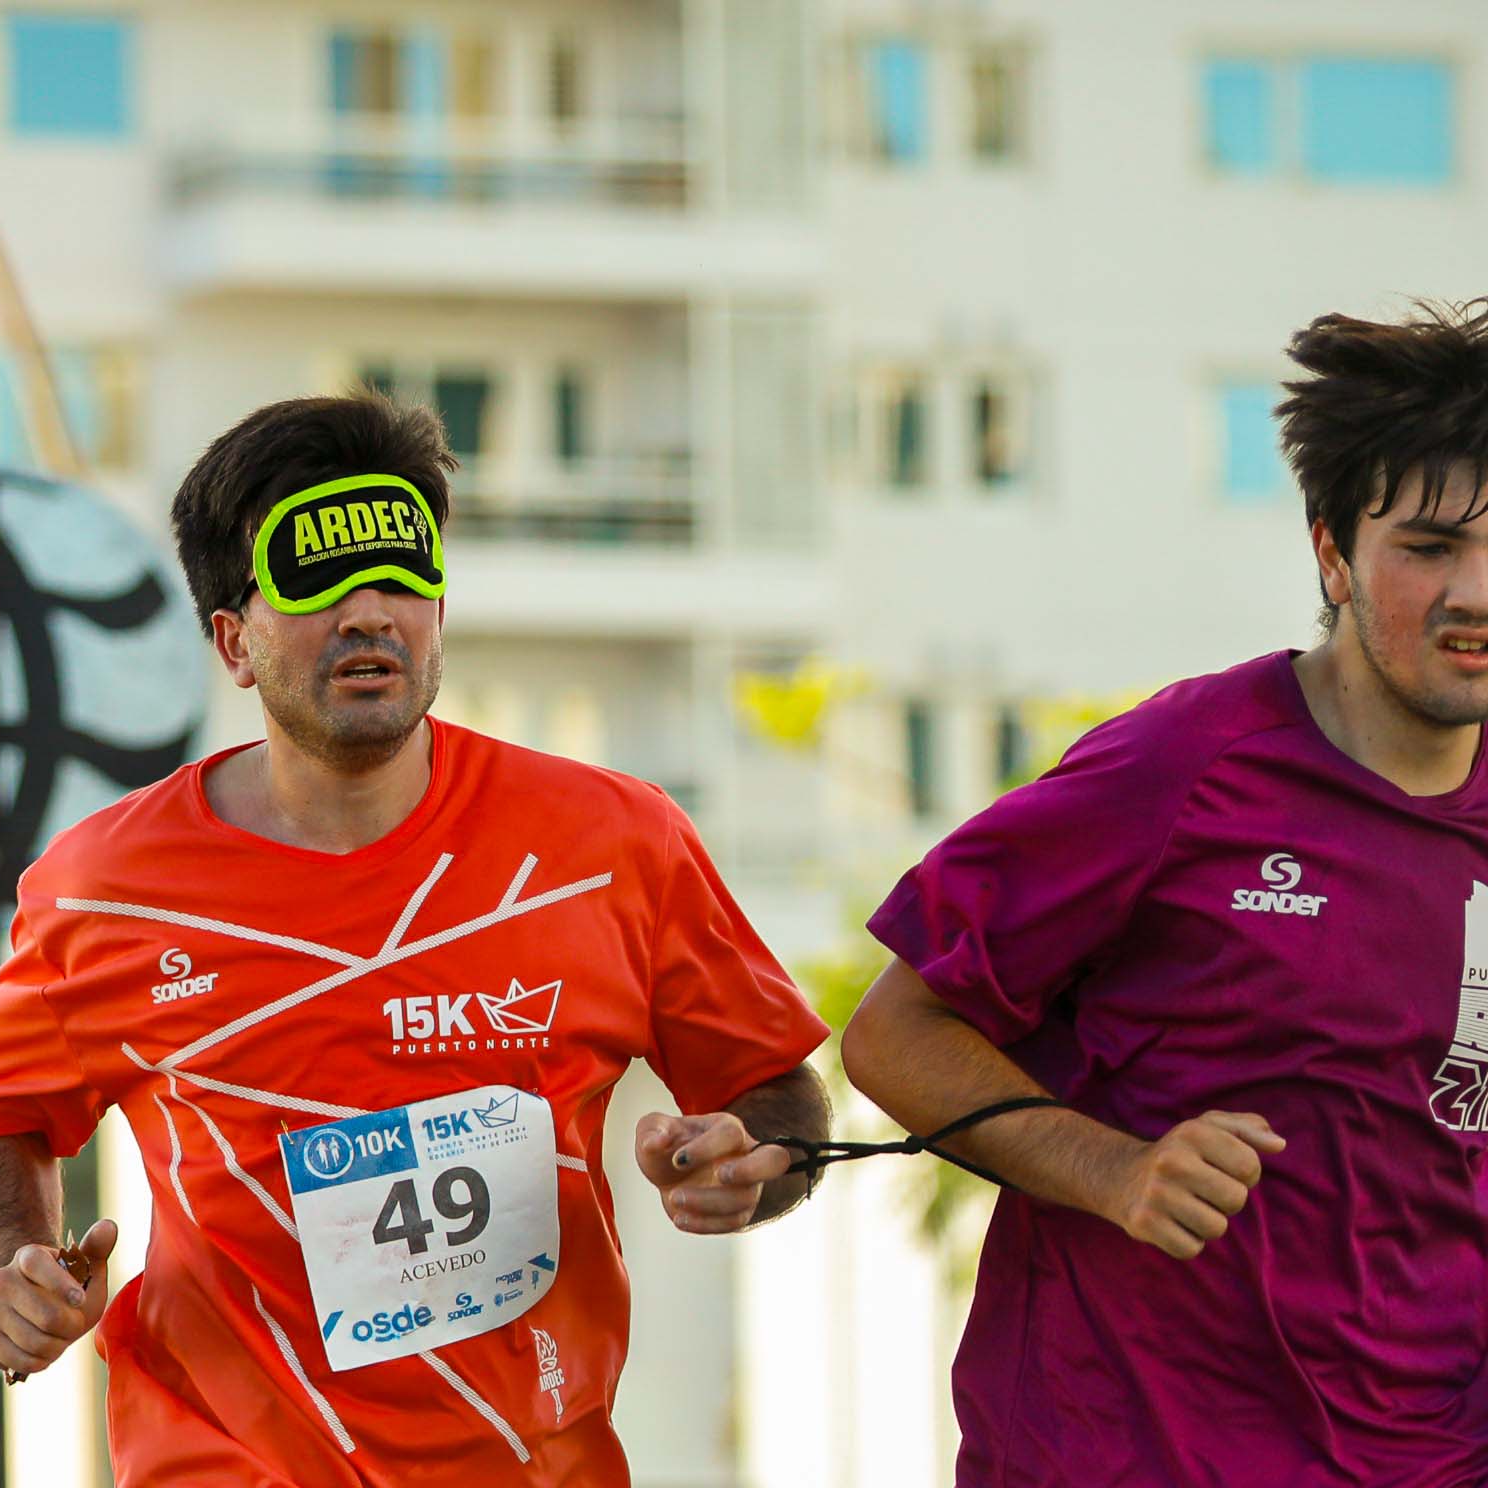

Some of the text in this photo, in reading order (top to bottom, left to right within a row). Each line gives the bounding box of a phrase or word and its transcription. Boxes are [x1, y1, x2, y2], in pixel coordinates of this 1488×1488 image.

[294, 501, 416, 557] ARDEC
[383, 993, 476, 1040] 15K
[393, 1037, 549, 1055] PUERTO NORTE
[354, 1125, 406, 1158] 10K
[422, 1110, 473, 1142] 15K
[372, 1166, 491, 1255] 49
[400, 1249, 486, 1283] ACEVEDO
[352, 1303, 432, 1342] osde
